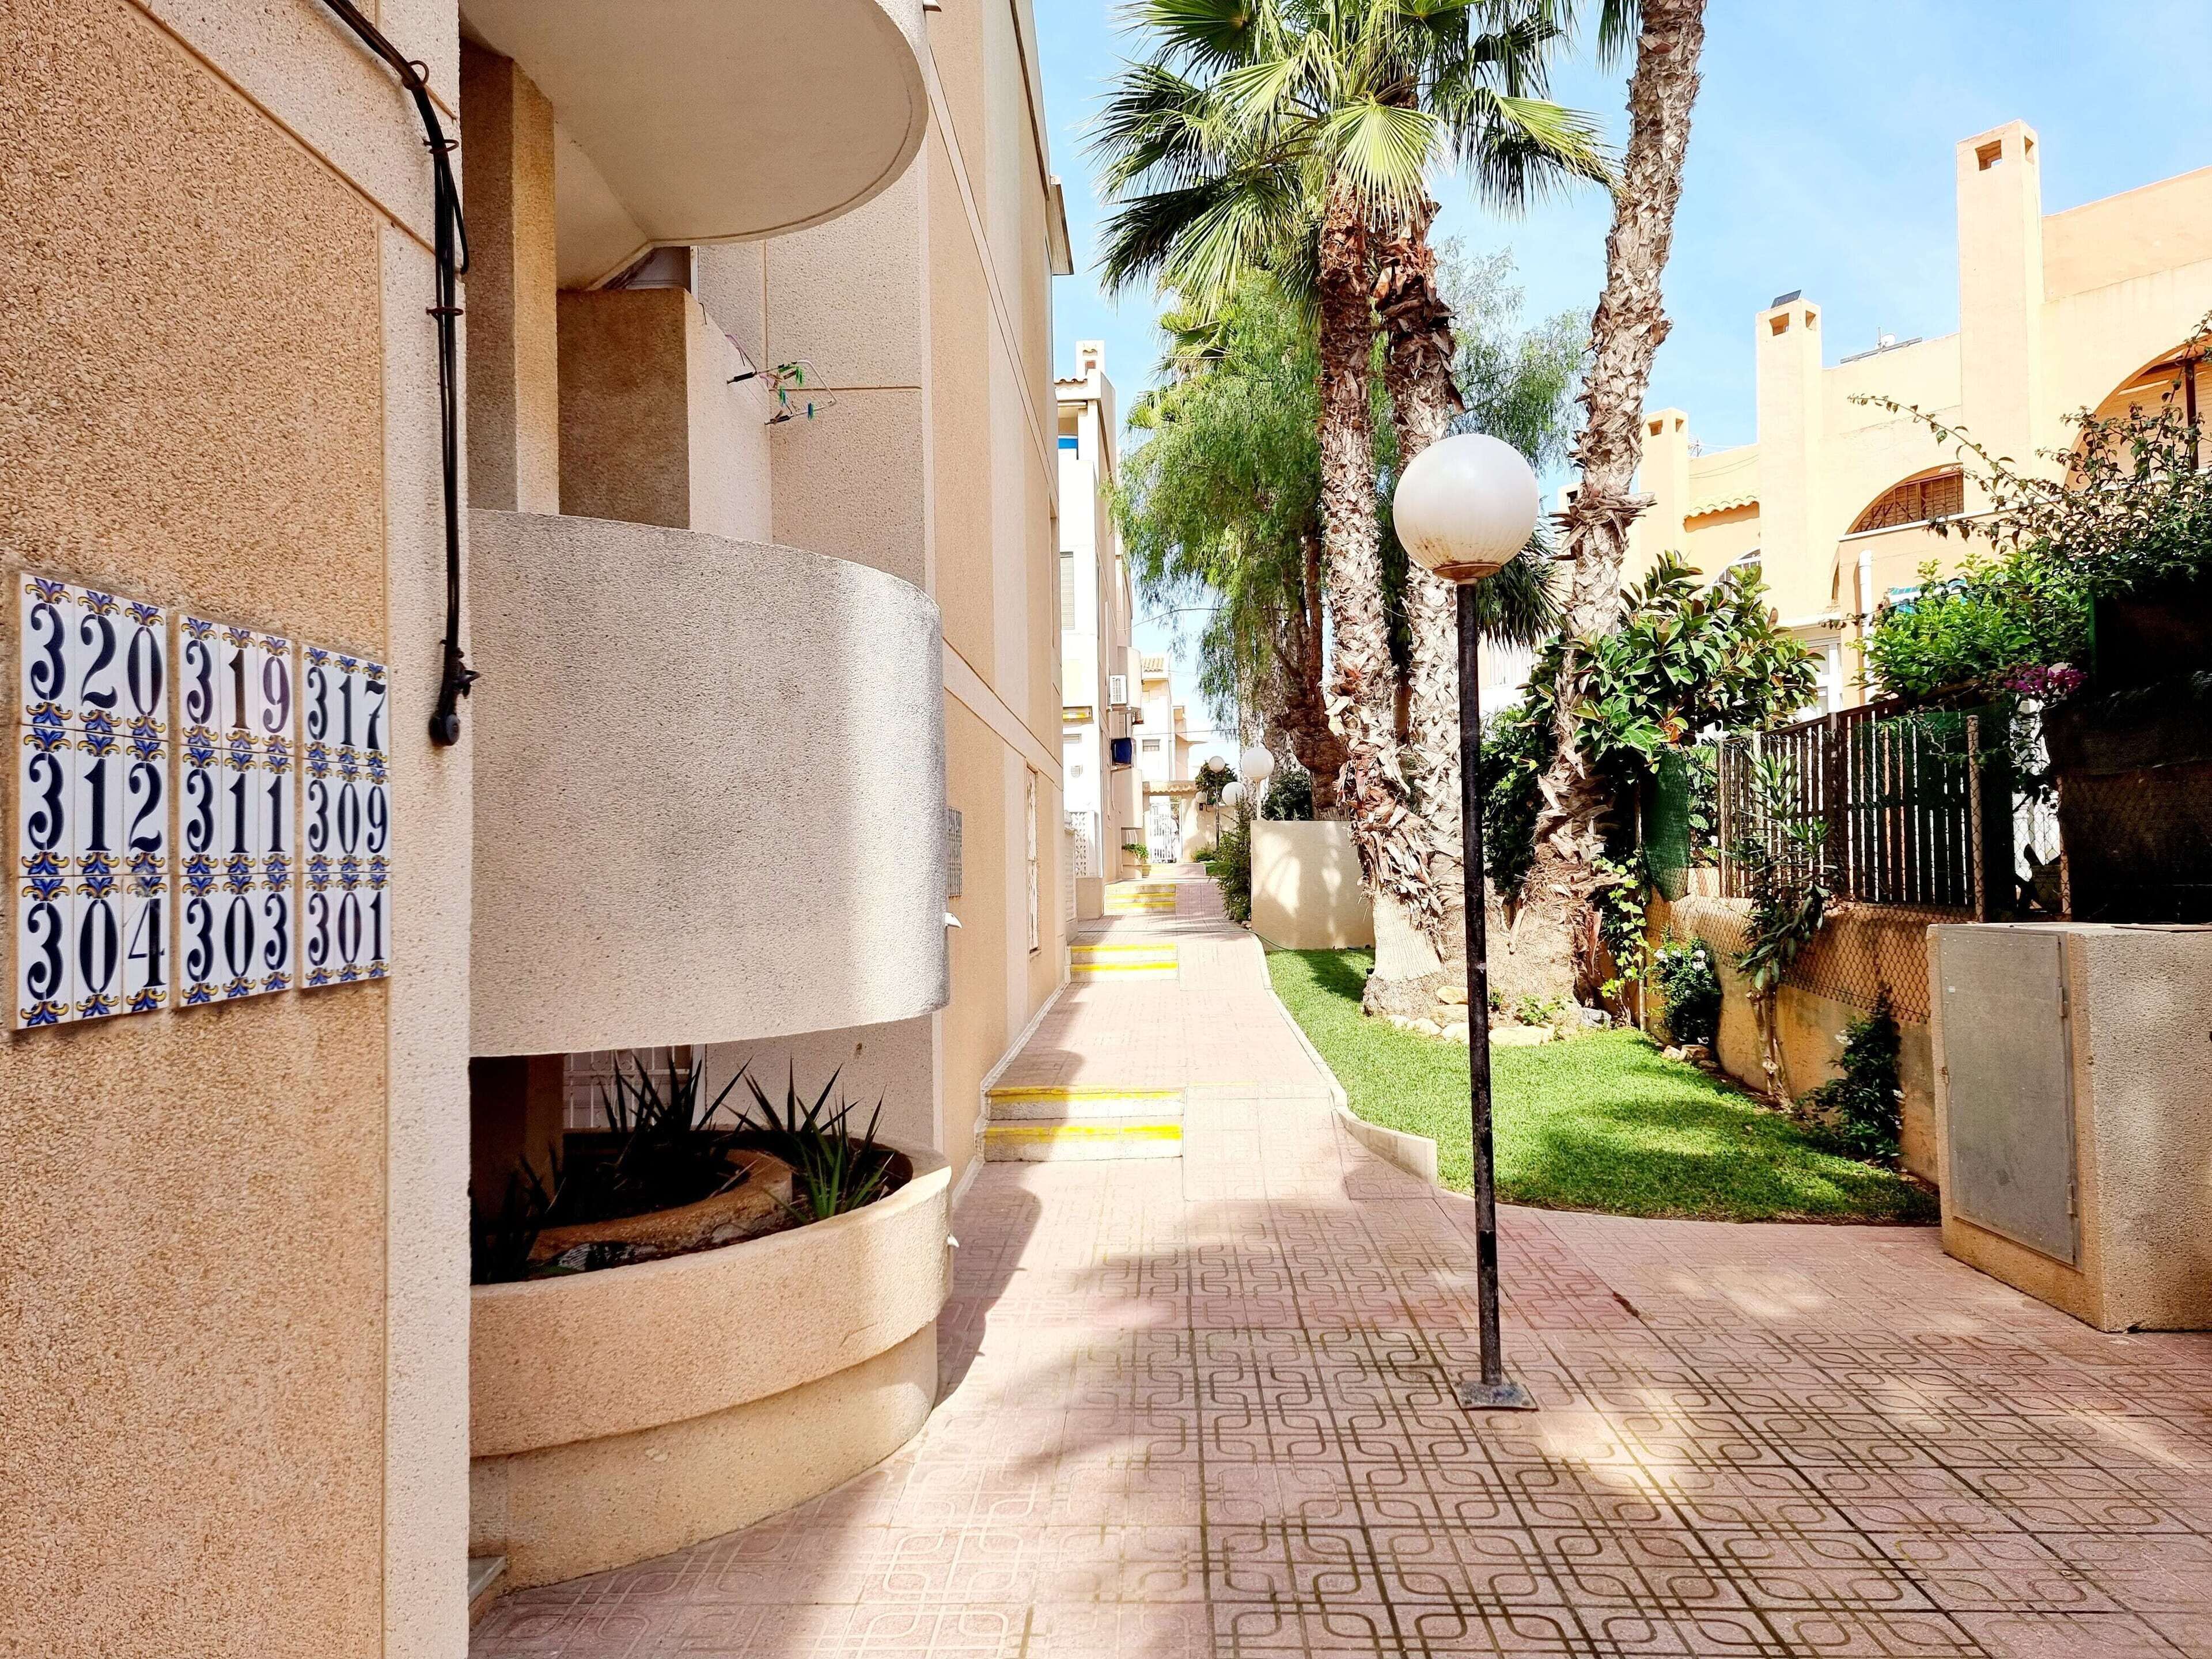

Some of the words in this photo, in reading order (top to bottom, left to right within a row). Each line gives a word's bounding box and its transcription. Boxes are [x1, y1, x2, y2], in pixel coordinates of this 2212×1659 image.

[30, 603, 163, 715] 320
[186, 639, 290, 733] 319
[308, 666, 387, 749] 317
[28, 752, 162, 854] 312
[186, 768, 286, 854] 311
[308, 779, 387, 854] 309
[27, 898, 166, 1000] 304
[186, 894, 287, 983] 303
[308, 891, 385, 965] 301
